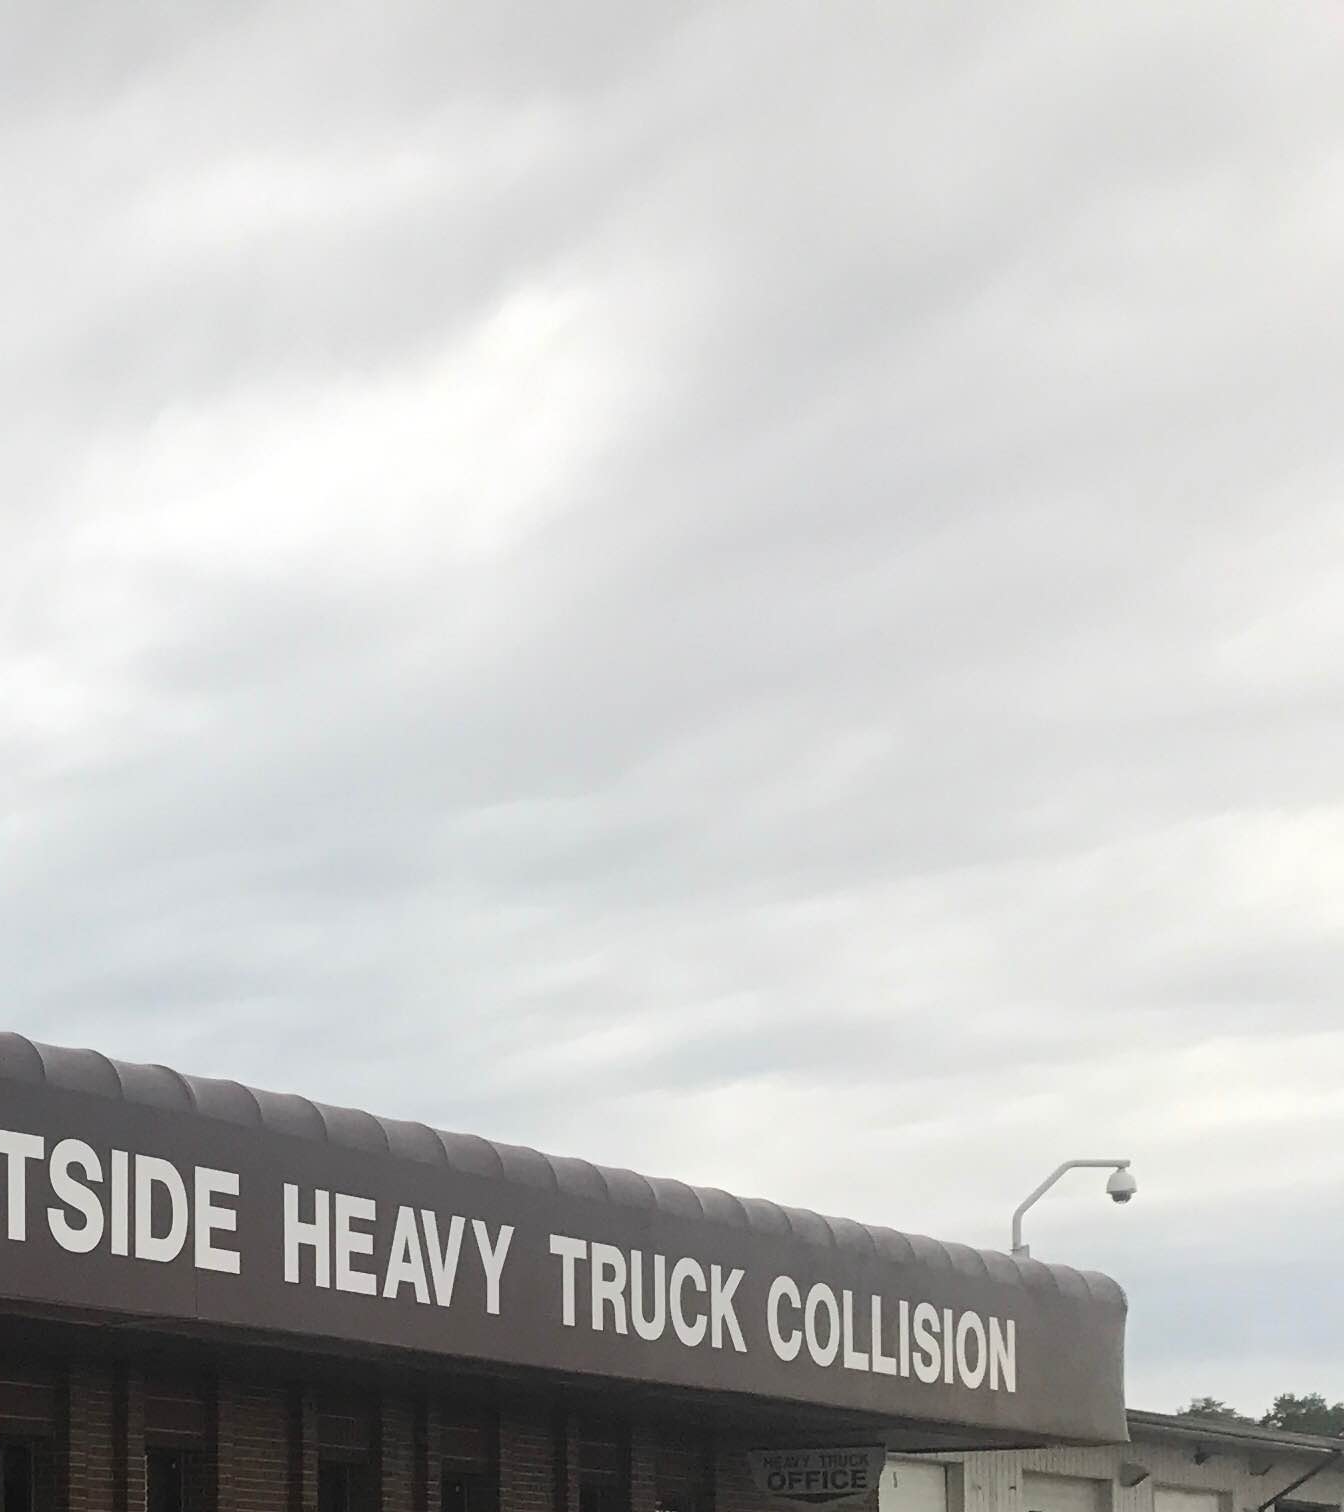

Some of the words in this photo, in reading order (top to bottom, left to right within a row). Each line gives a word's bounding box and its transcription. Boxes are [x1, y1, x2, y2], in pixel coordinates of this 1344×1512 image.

[283, 1182, 514, 1315] HEAVY
[549, 1234, 747, 1353] TRUCK
[767, 1275, 1016, 1393] COLLISION
[767, 1469, 868, 1491] OFFICE
